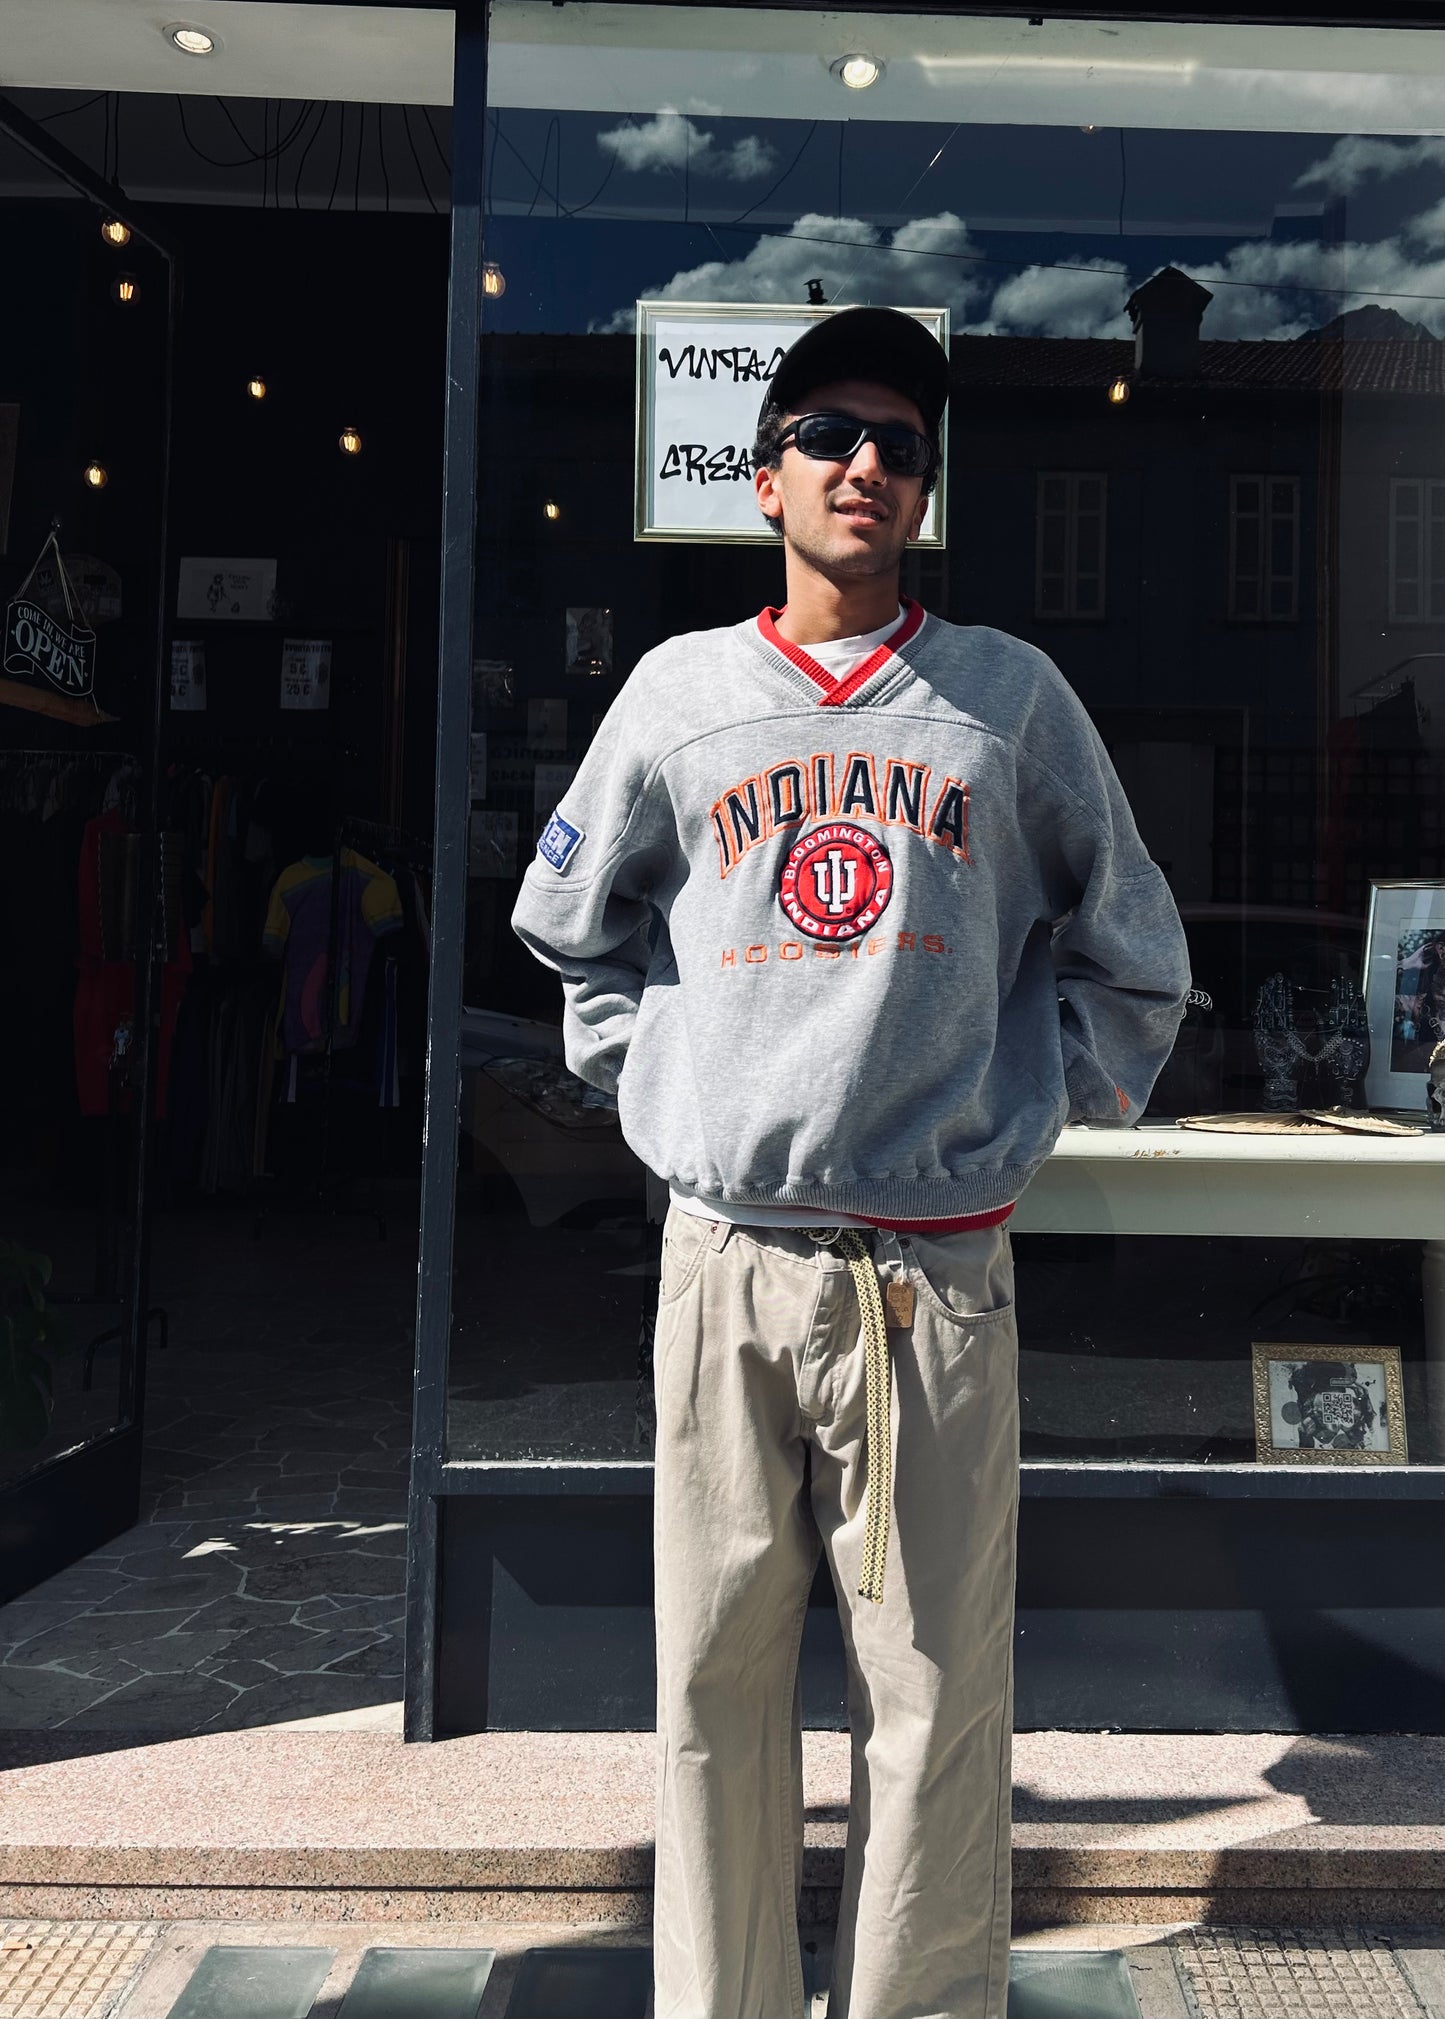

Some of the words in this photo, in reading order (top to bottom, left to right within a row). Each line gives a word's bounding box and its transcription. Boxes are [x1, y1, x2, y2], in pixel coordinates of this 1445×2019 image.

[15, 618, 86, 688] OPEN
[17, 606, 43, 625] COME
[55, 633, 67, 649] WE
[68, 642, 85, 658] ARE
[709, 751, 971, 879] INDIANA
[784, 826, 891, 879] BLOOMINGTON
[782, 888, 887, 936] INDIANA
[720, 931, 947, 968] HOOSIERS
